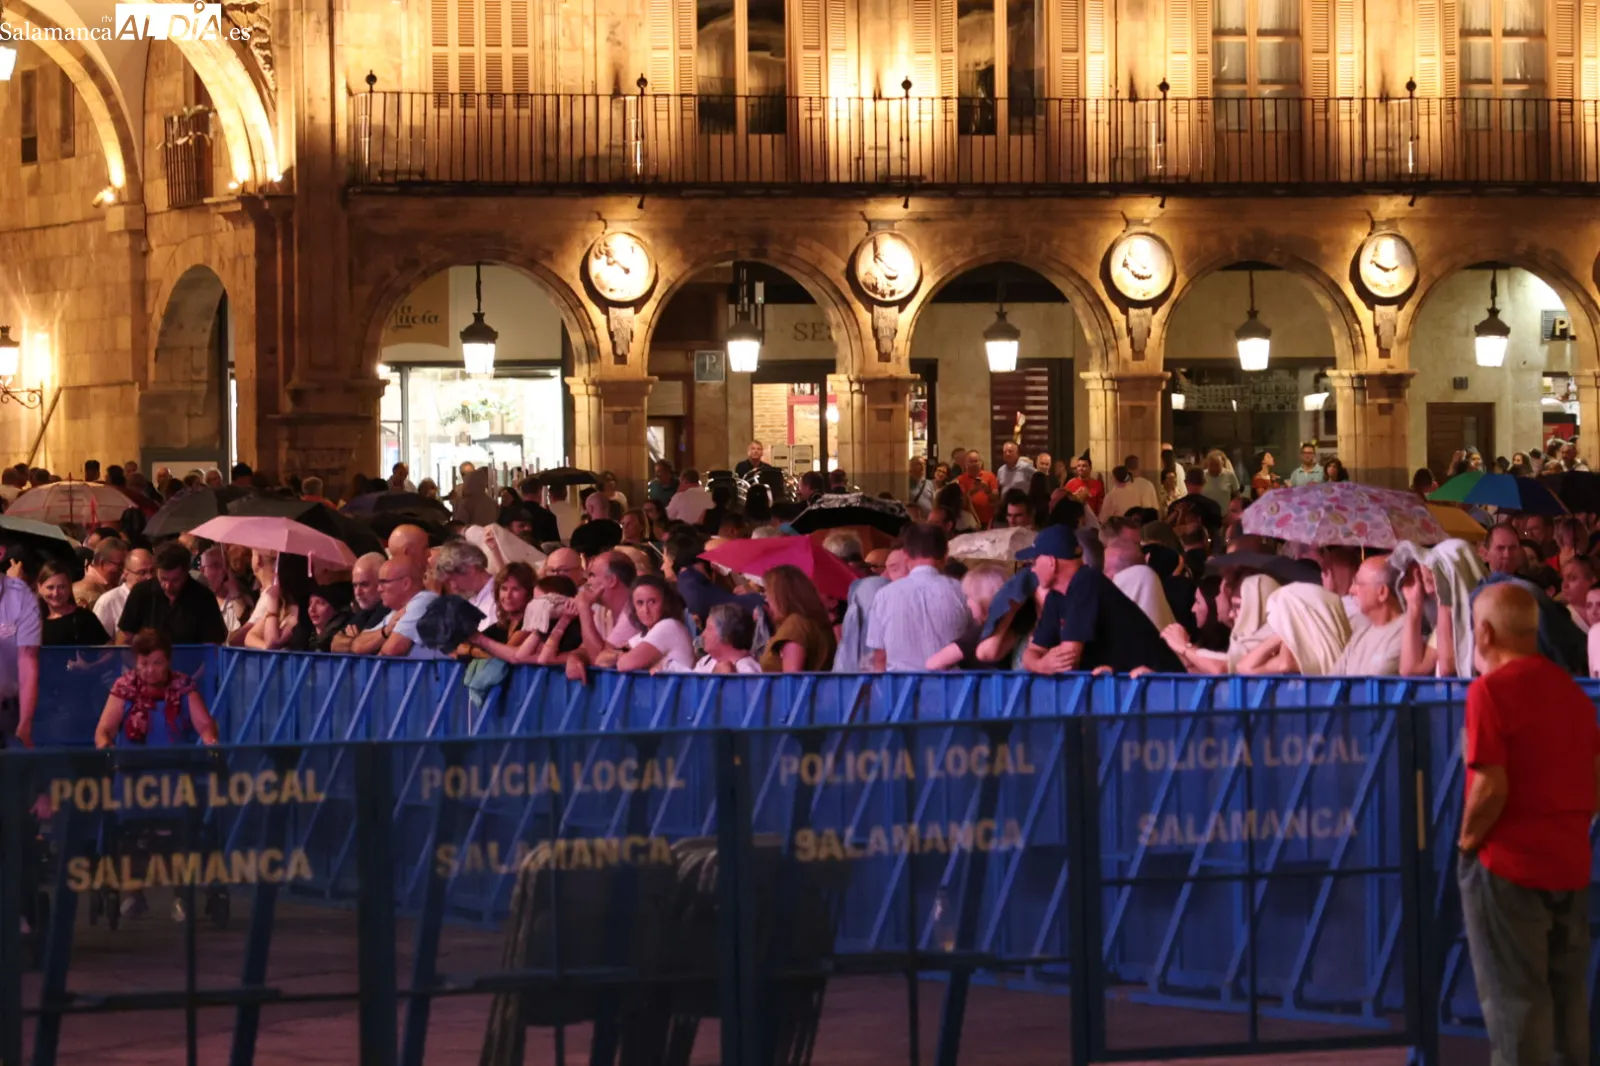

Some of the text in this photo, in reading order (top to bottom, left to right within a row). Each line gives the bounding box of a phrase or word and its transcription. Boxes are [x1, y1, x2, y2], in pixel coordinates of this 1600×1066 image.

[779, 742, 1035, 787] POLICIA LOCAL
[1121, 732, 1369, 772] POLICIA LOCAL
[50, 769, 326, 811] POLICIA LOCAL
[420, 756, 686, 801] POLICIA LOCAL
[794, 817, 1023, 863] SALAMANCA
[1137, 807, 1359, 846] SALAMANCA
[66, 844, 314, 892] SALAMANCA
